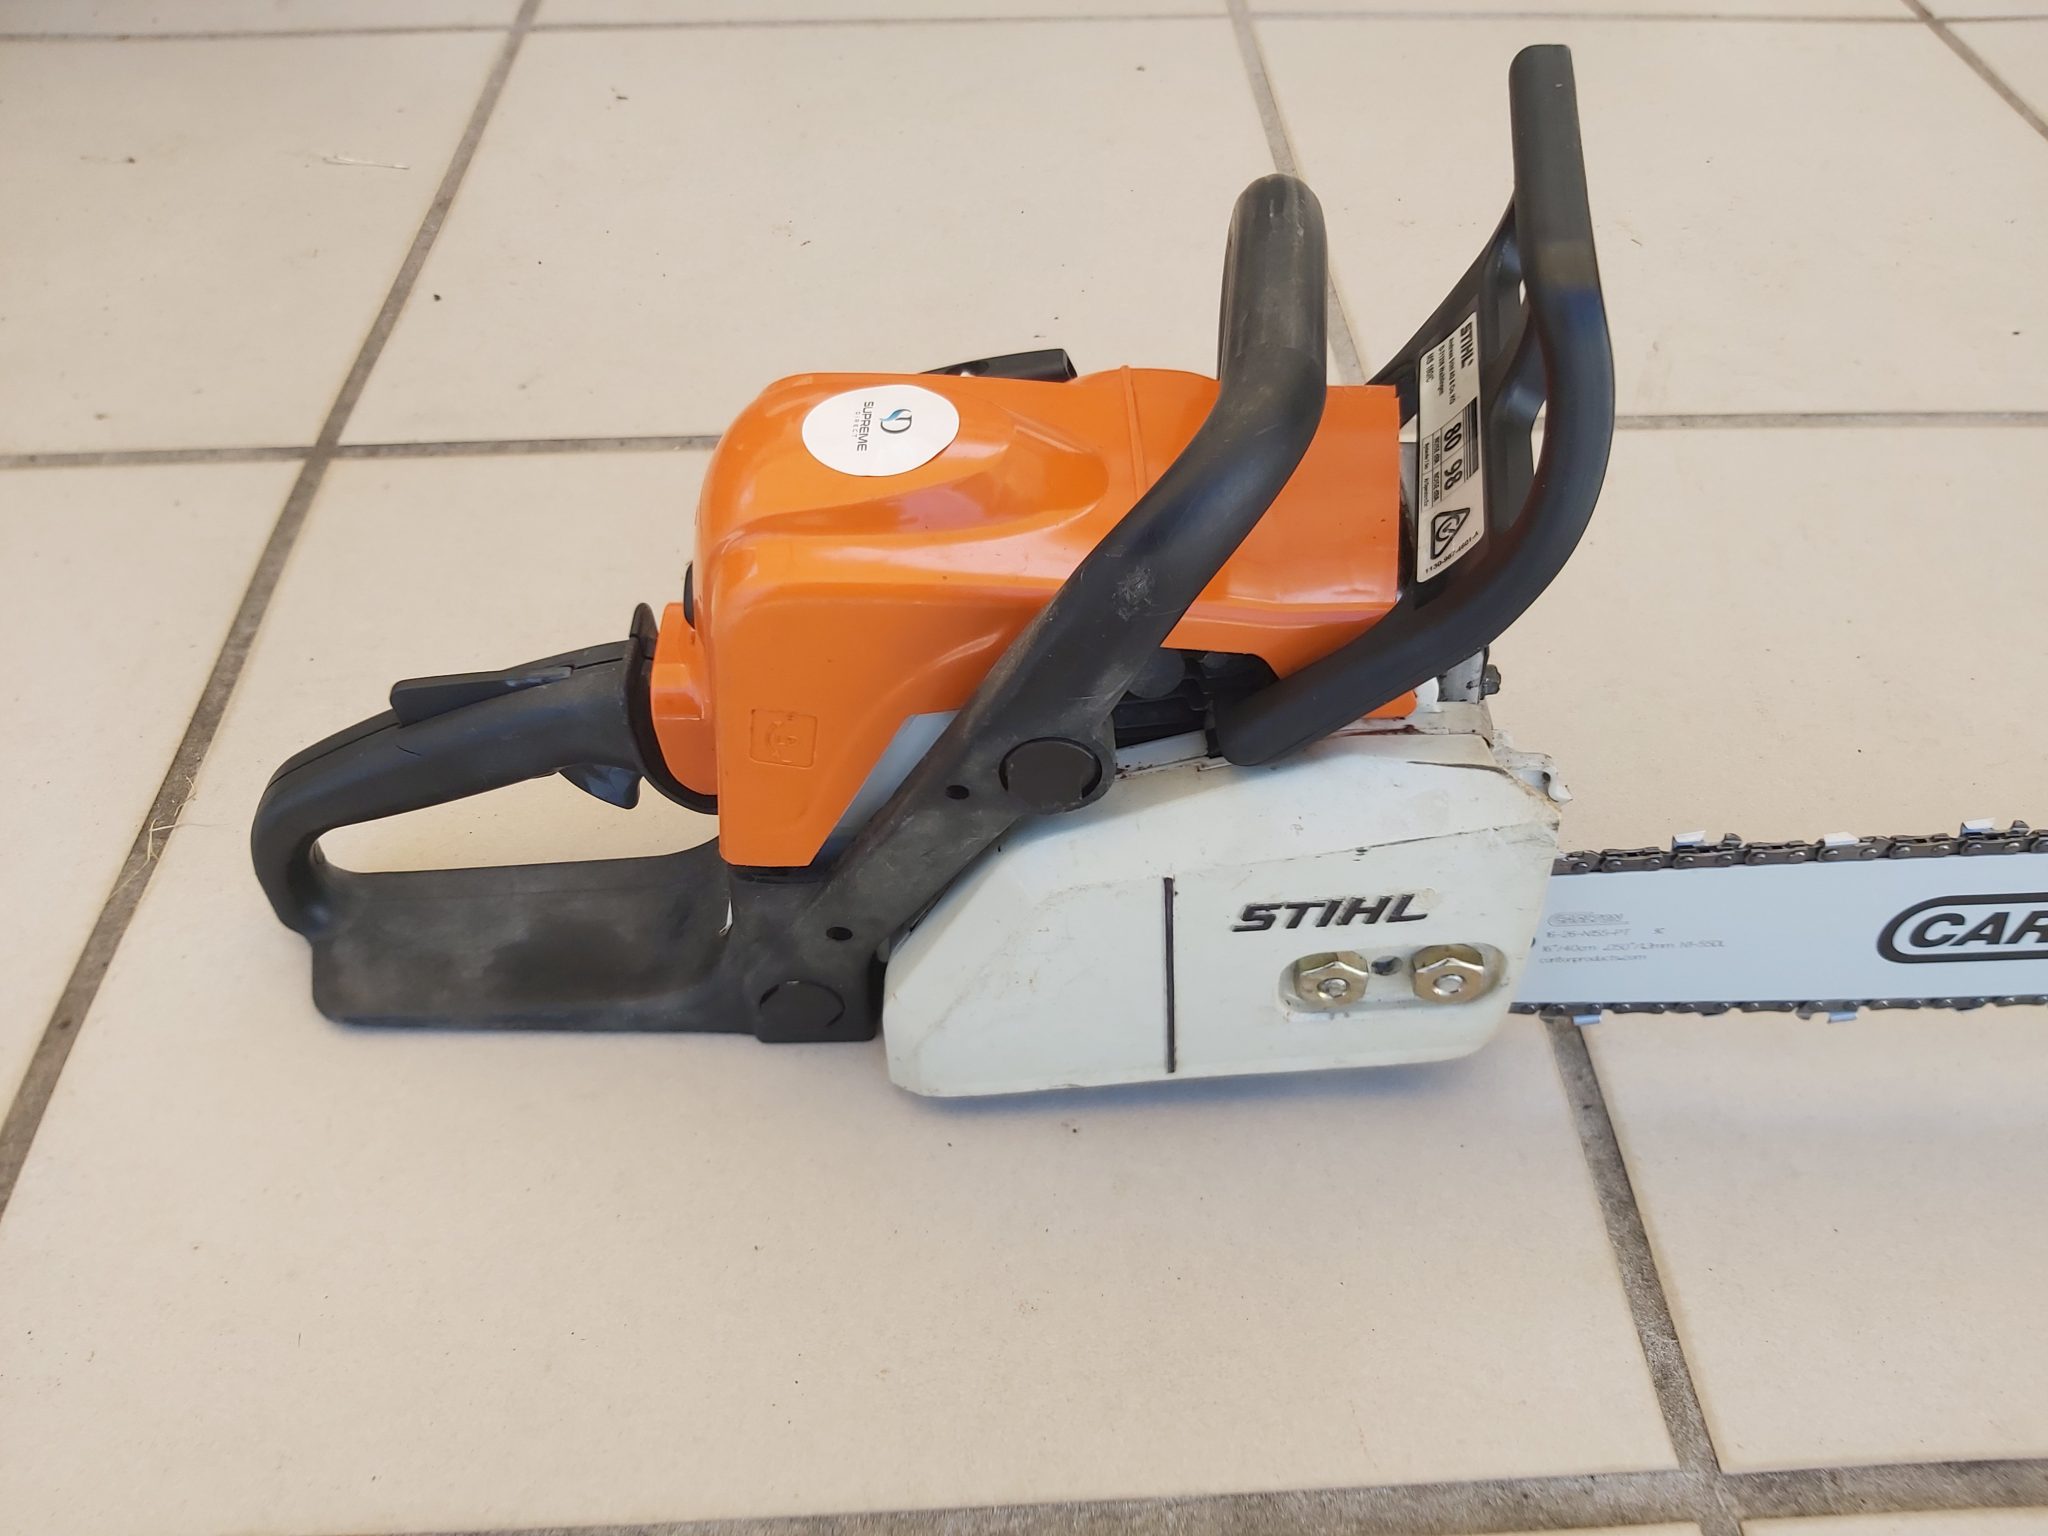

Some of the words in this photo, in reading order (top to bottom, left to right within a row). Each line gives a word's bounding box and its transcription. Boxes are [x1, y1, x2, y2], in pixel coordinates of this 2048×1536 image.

[1460, 321, 1474, 369] STIHL
[851, 411, 861, 438] DIRECT
[856, 401, 874, 452] SUPREME
[1444, 422, 1462, 453] 80
[1444, 458, 1463, 491] 98
[1231, 893, 1428, 932] STIHL
[1909, 910, 2048, 948] CAR
